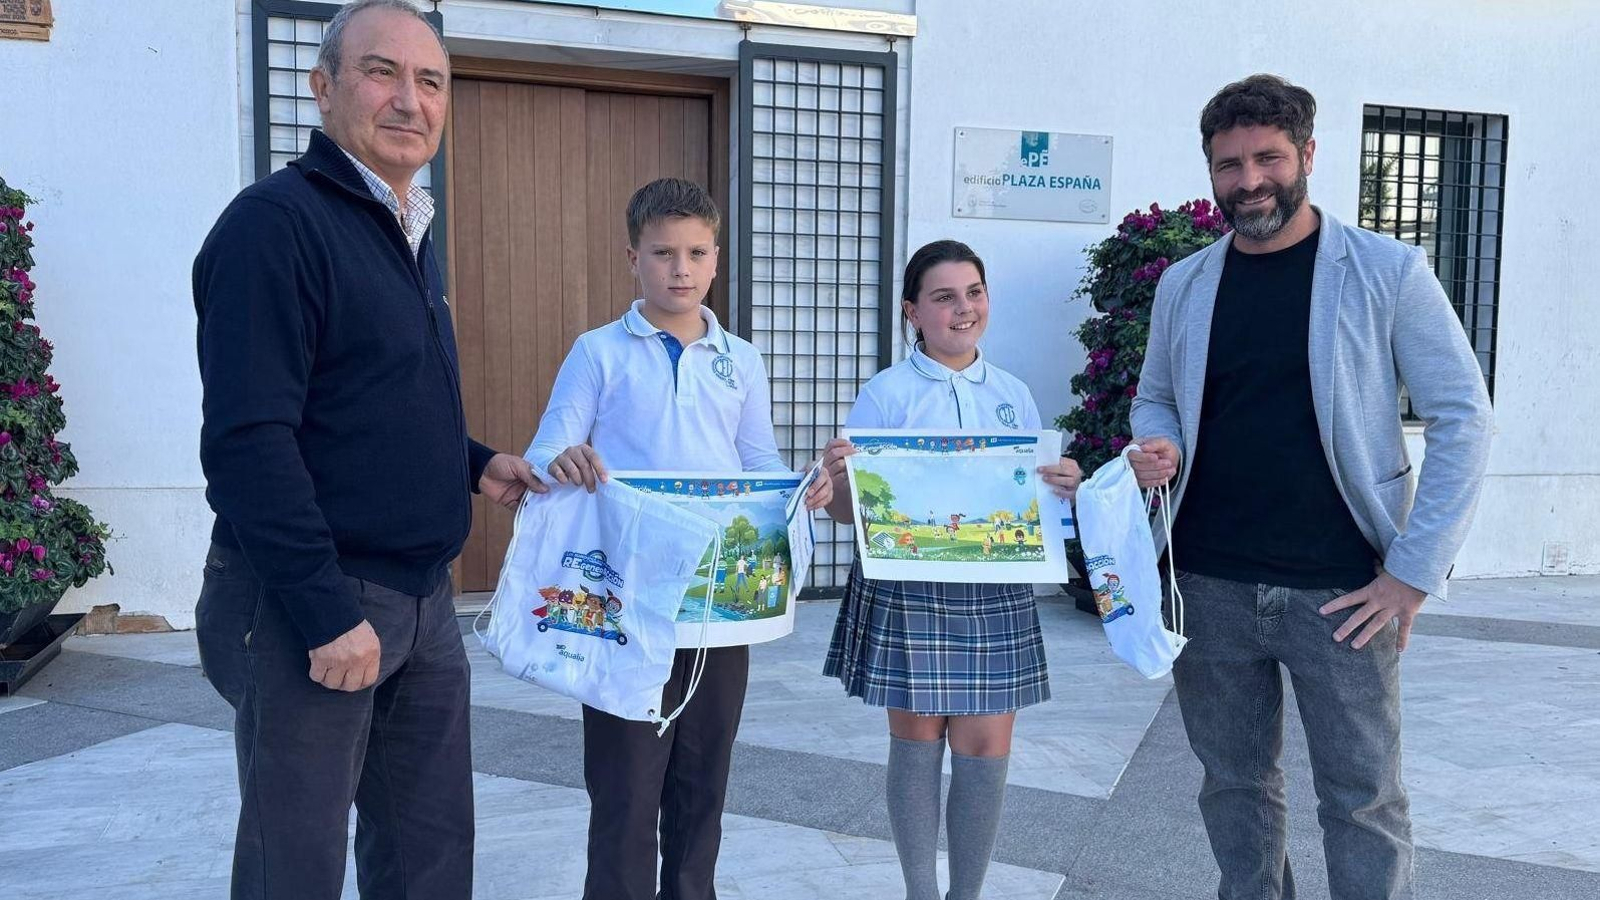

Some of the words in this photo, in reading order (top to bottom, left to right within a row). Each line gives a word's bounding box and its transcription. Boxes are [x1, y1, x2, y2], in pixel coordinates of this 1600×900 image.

[963, 174, 1001, 186] edificio
[1001, 173, 1046, 188] PLAZA
[1049, 174, 1101, 190] ESPAÑA
[558, 649, 585, 662] aqualia
